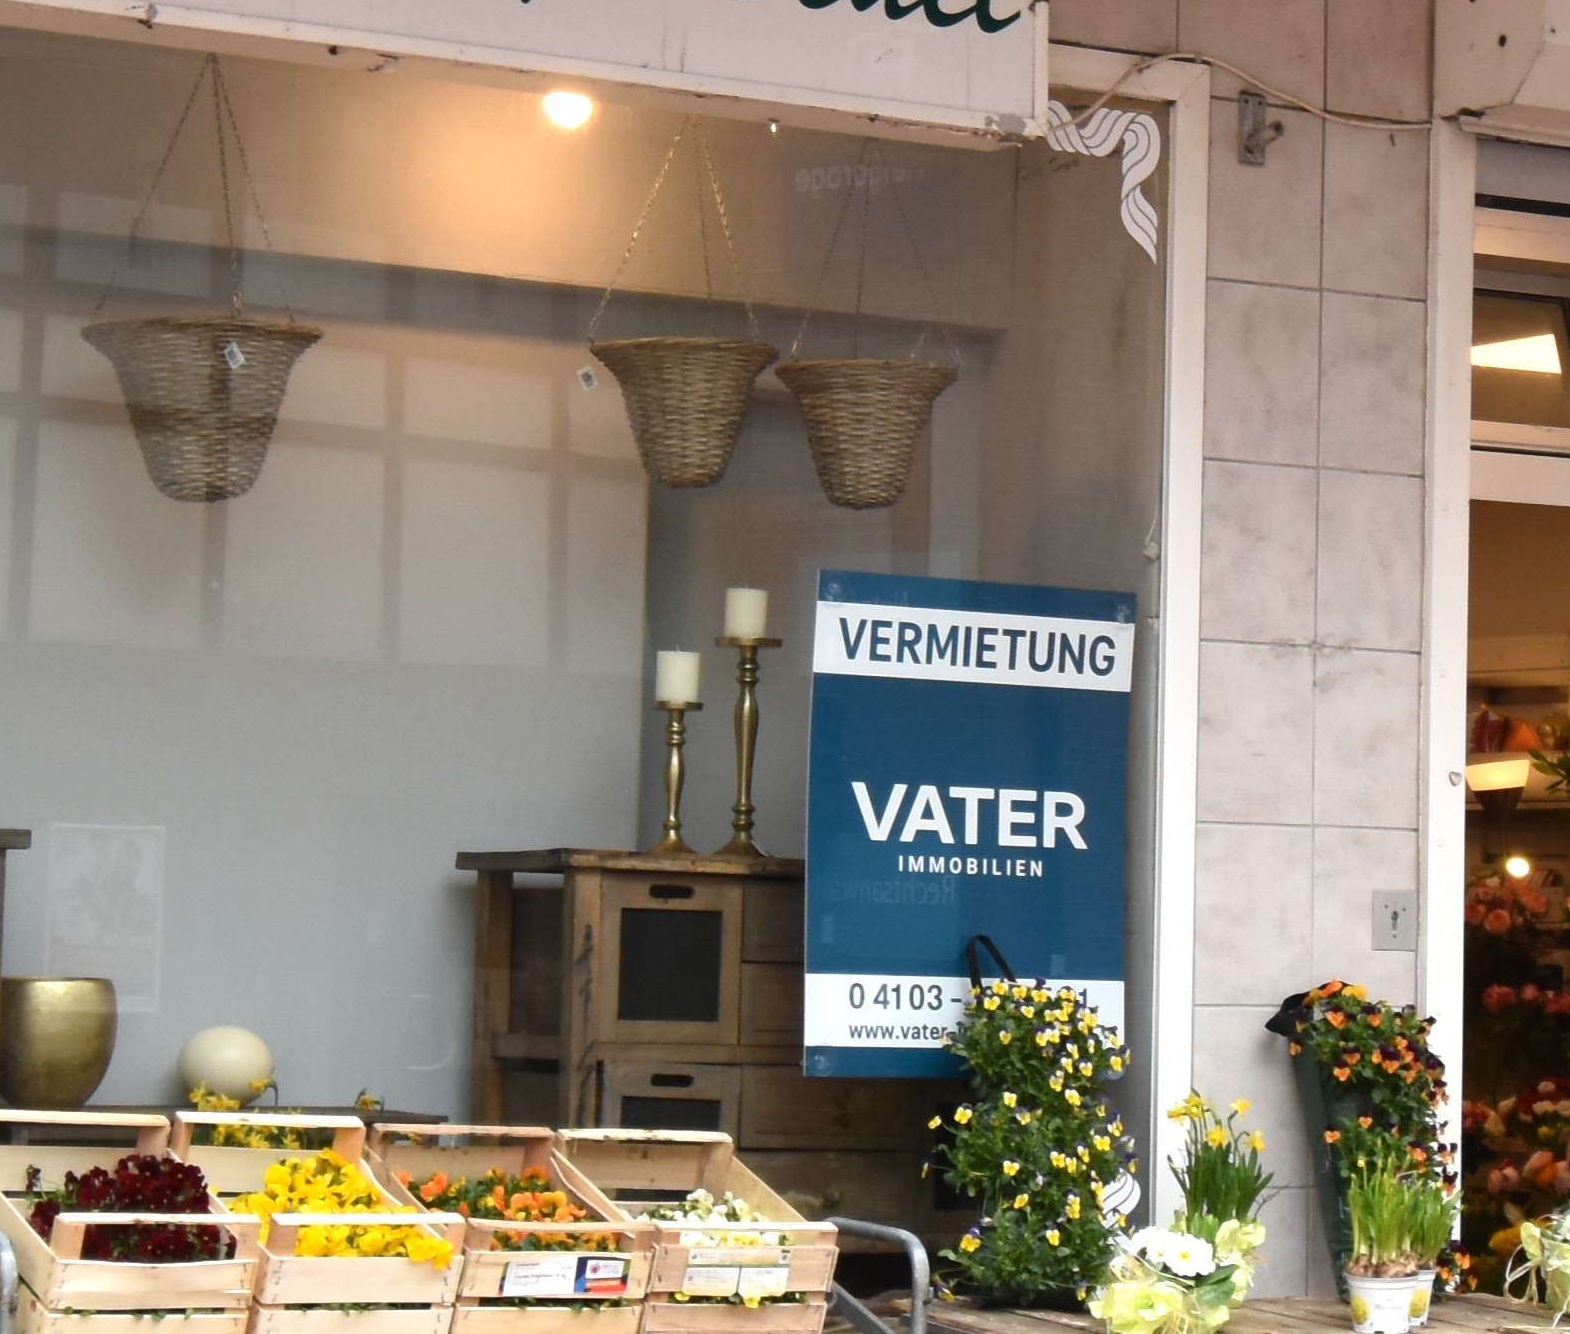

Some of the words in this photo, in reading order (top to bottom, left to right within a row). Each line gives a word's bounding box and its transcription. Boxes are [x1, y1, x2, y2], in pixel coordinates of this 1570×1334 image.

[838, 616, 1117, 678] VERMIETUNG
[851, 780, 1089, 851] VATER
[898, 854, 1045, 879] IMMOBILIEN
[849, 982, 865, 1009] 0
[873, 983, 943, 1011] 4103
